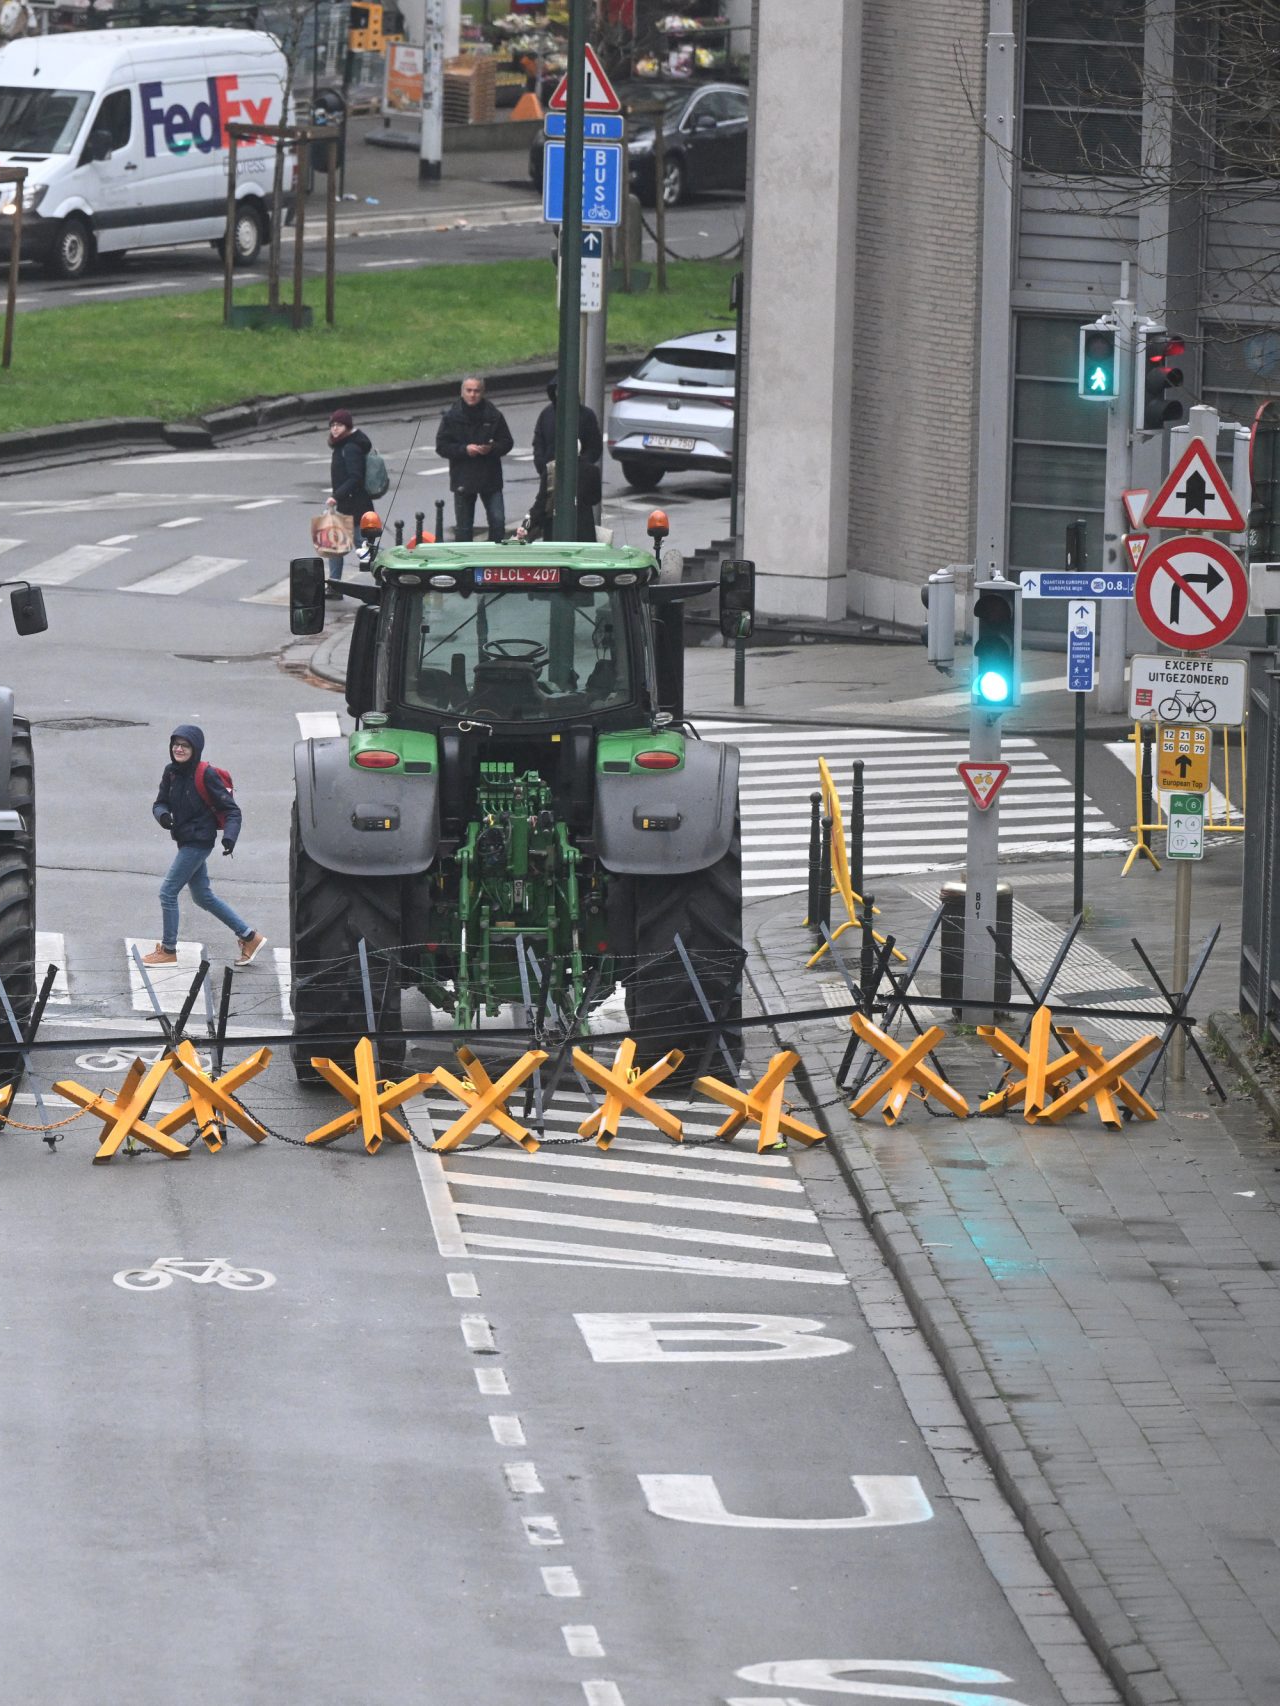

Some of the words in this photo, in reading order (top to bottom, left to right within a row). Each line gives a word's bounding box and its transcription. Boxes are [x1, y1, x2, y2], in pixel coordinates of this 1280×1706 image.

[139, 74, 276, 158] FedEx
[593, 150, 607, 202] BUS
[1165, 660, 1214, 673] EXCEPTE
[1148, 672, 1230, 686] UITGEZONDERD
[1165, 730, 1175, 739] 12
[1180, 731, 1190, 740] 21
[1195, 732, 1205, 741] 36
[1164, 743, 1174, 751] 56
[1179, 743, 1189, 752] 60
[1194, 744, 1205, 753] 79
[1162, 778, 1191, 789] European
[1192, 779, 1203, 788] Top
